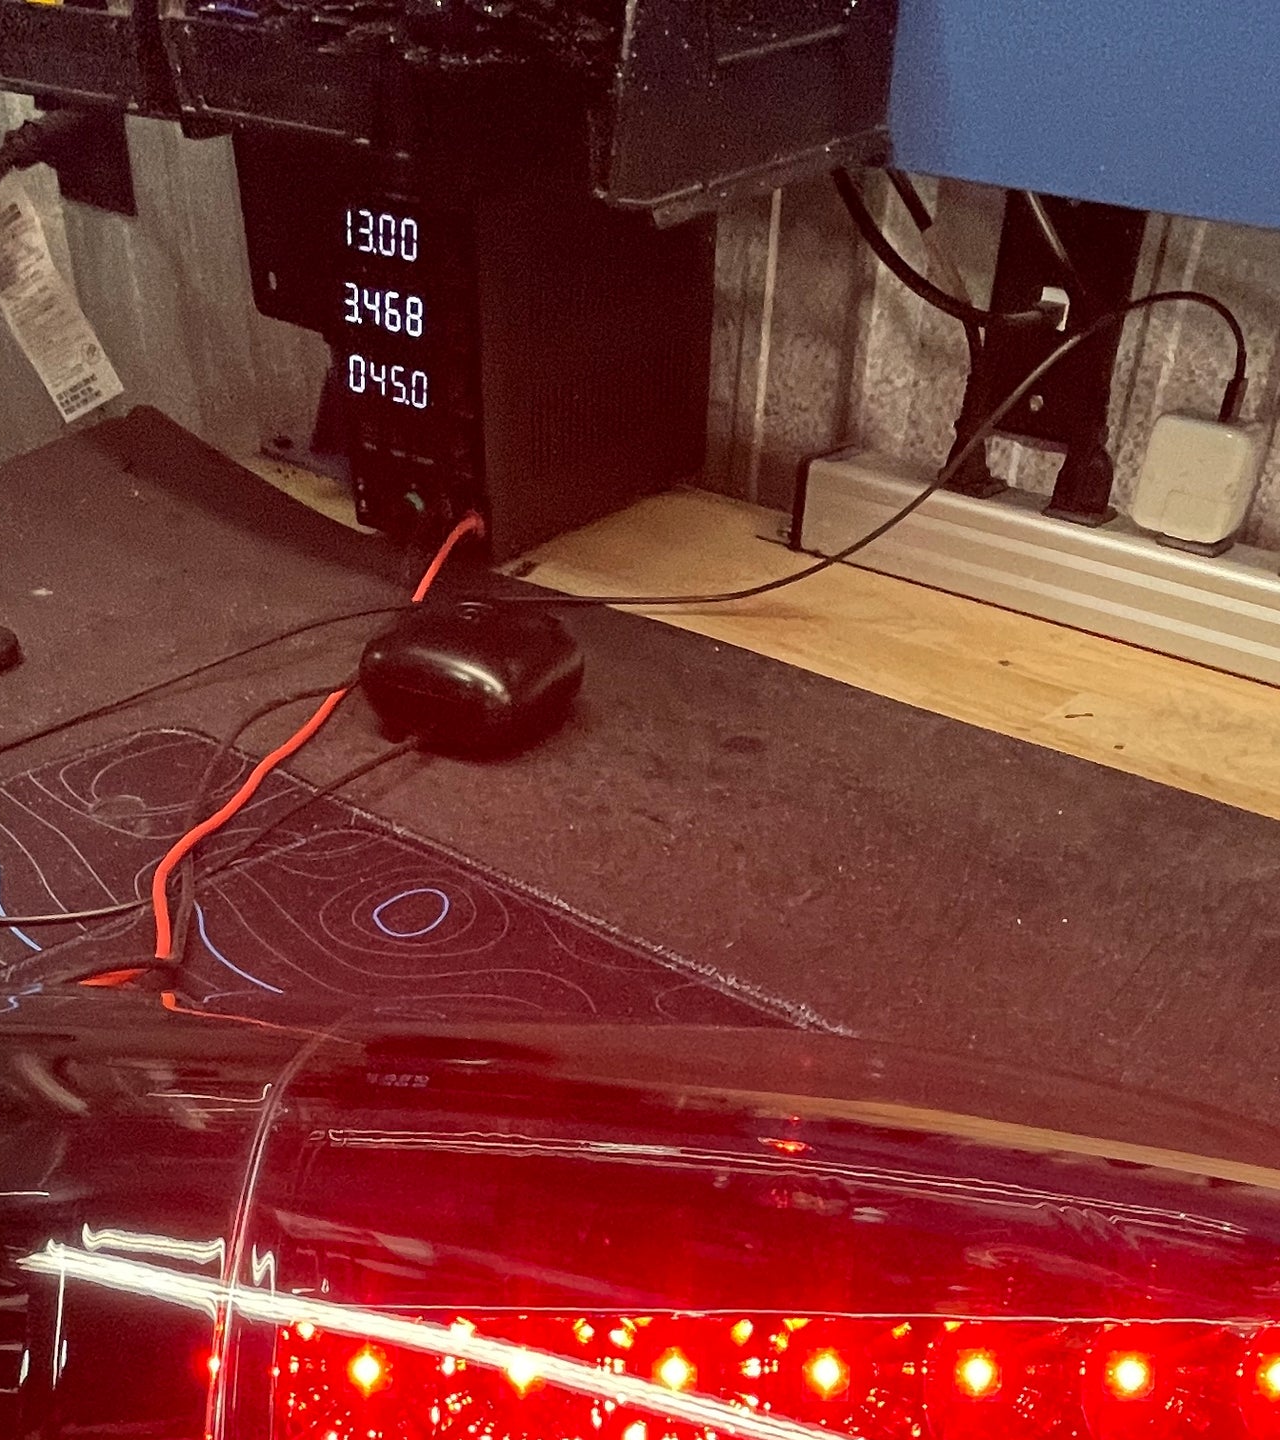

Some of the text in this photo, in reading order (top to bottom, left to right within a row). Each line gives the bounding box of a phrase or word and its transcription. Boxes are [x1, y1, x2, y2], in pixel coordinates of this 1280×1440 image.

[346, 208, 418, 262] 13.00
[344, 281, 423, 338] 3.468
[348, 354, 428, 409] 045.0
